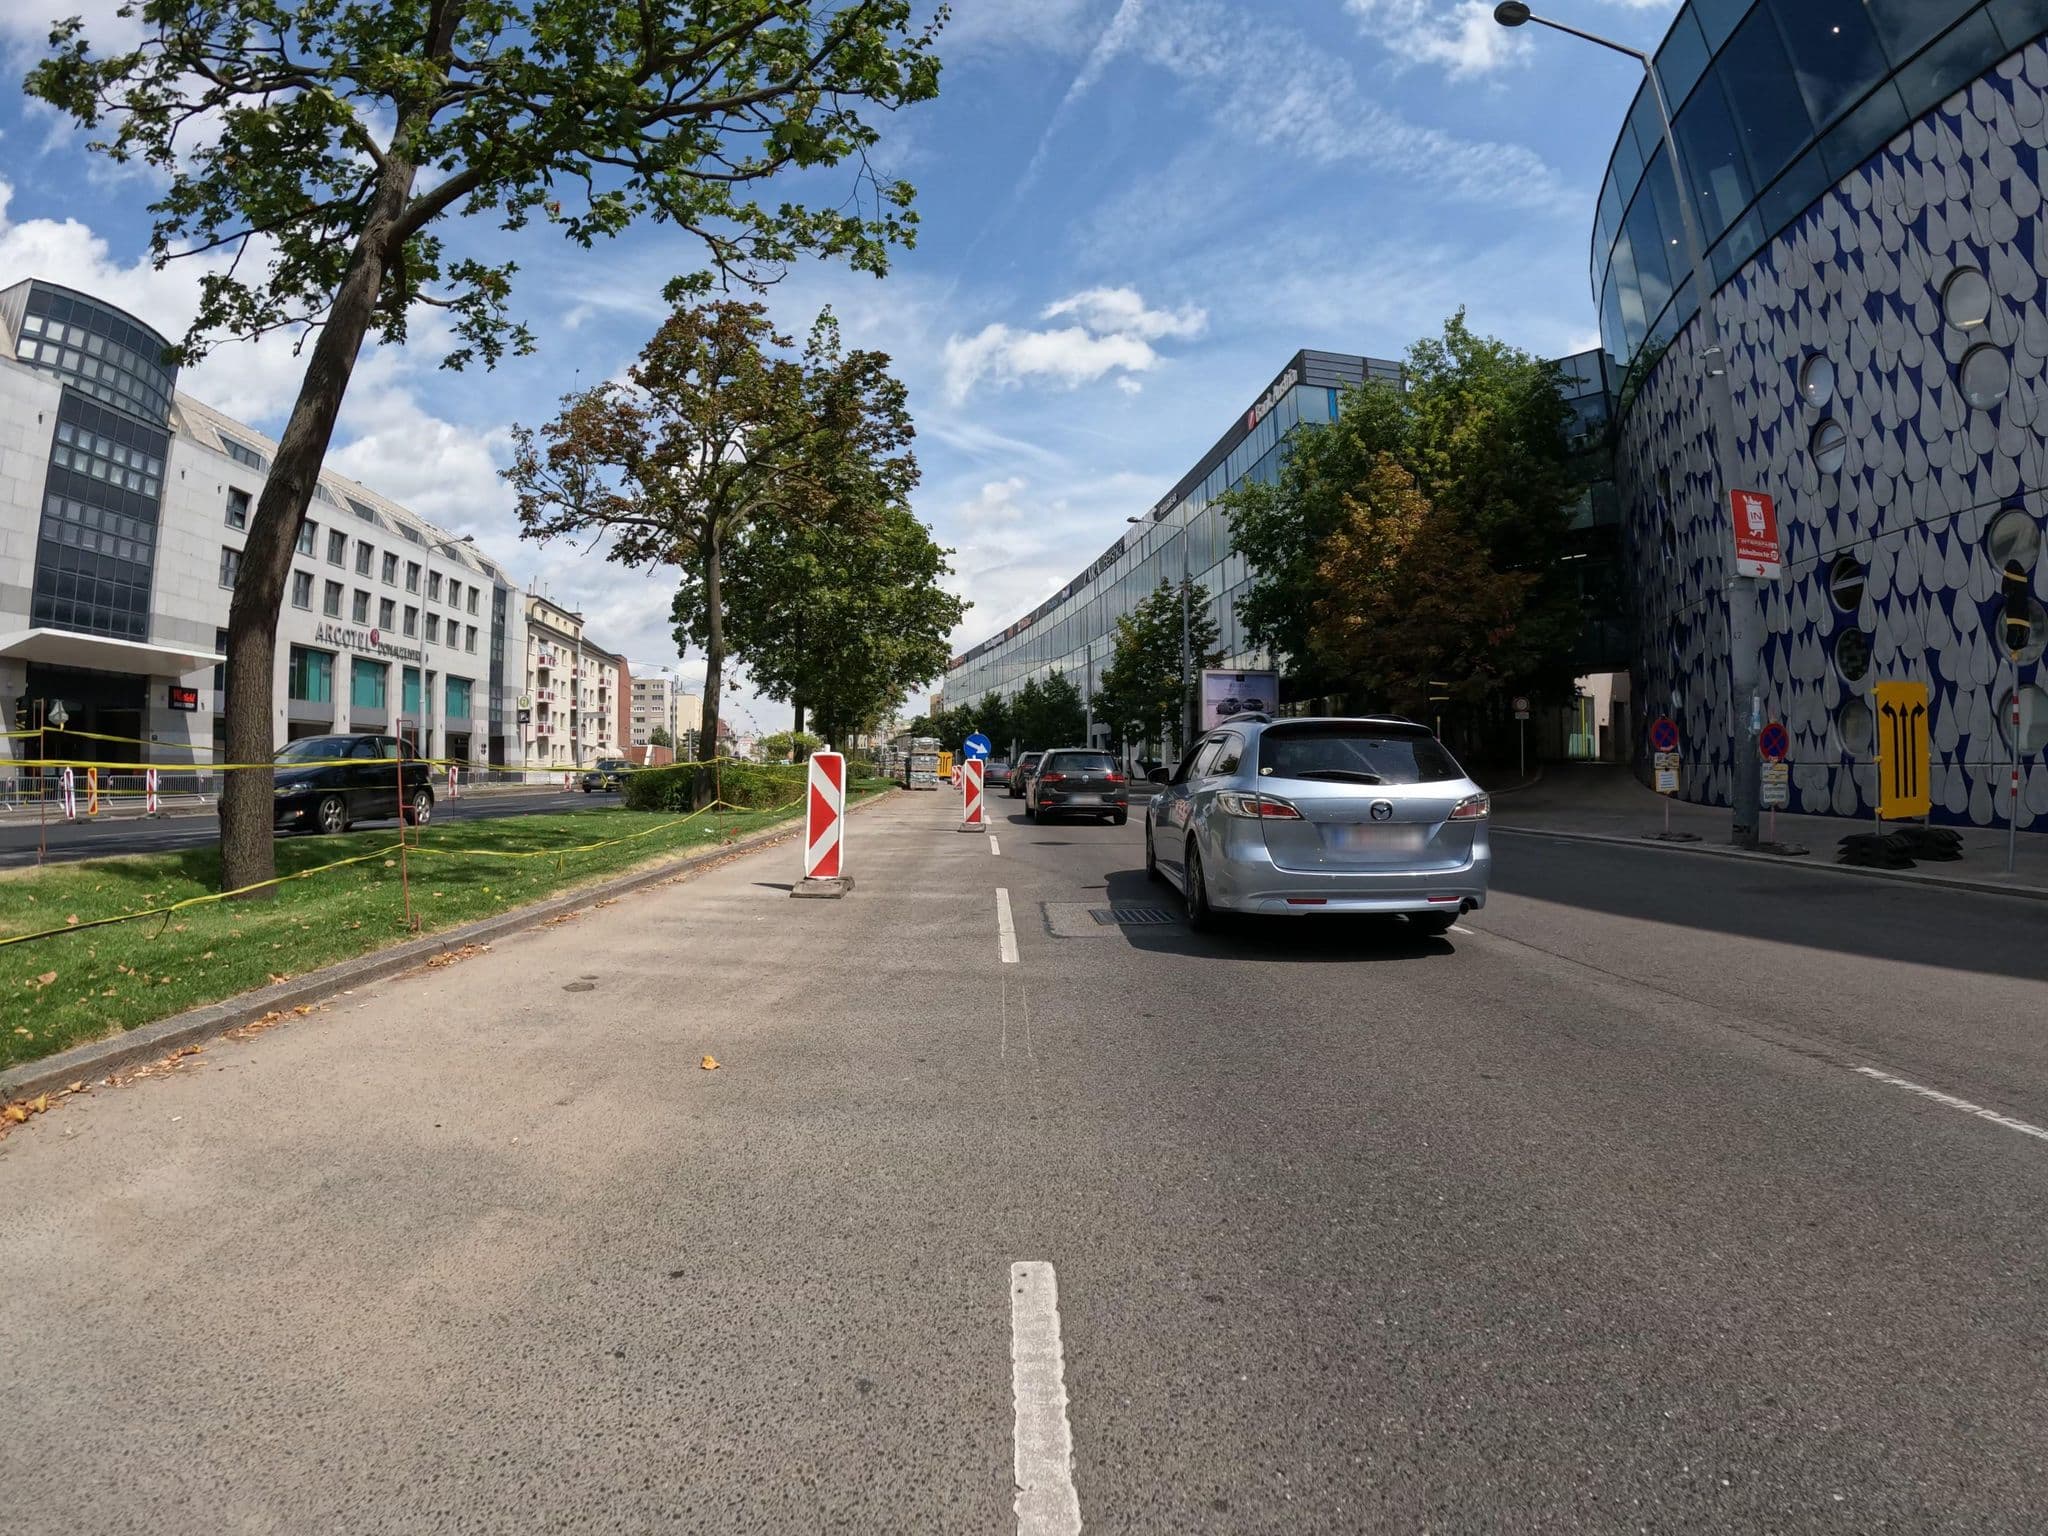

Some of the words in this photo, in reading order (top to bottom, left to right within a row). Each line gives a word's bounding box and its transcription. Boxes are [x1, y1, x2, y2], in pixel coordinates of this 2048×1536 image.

[1255, 392, 1274, 423] Bank
[1272, 368, 1298, 405] Austria
[1750, 511, 1763, 521] IN
[315, 621, 371, 653] ARCOTEL
